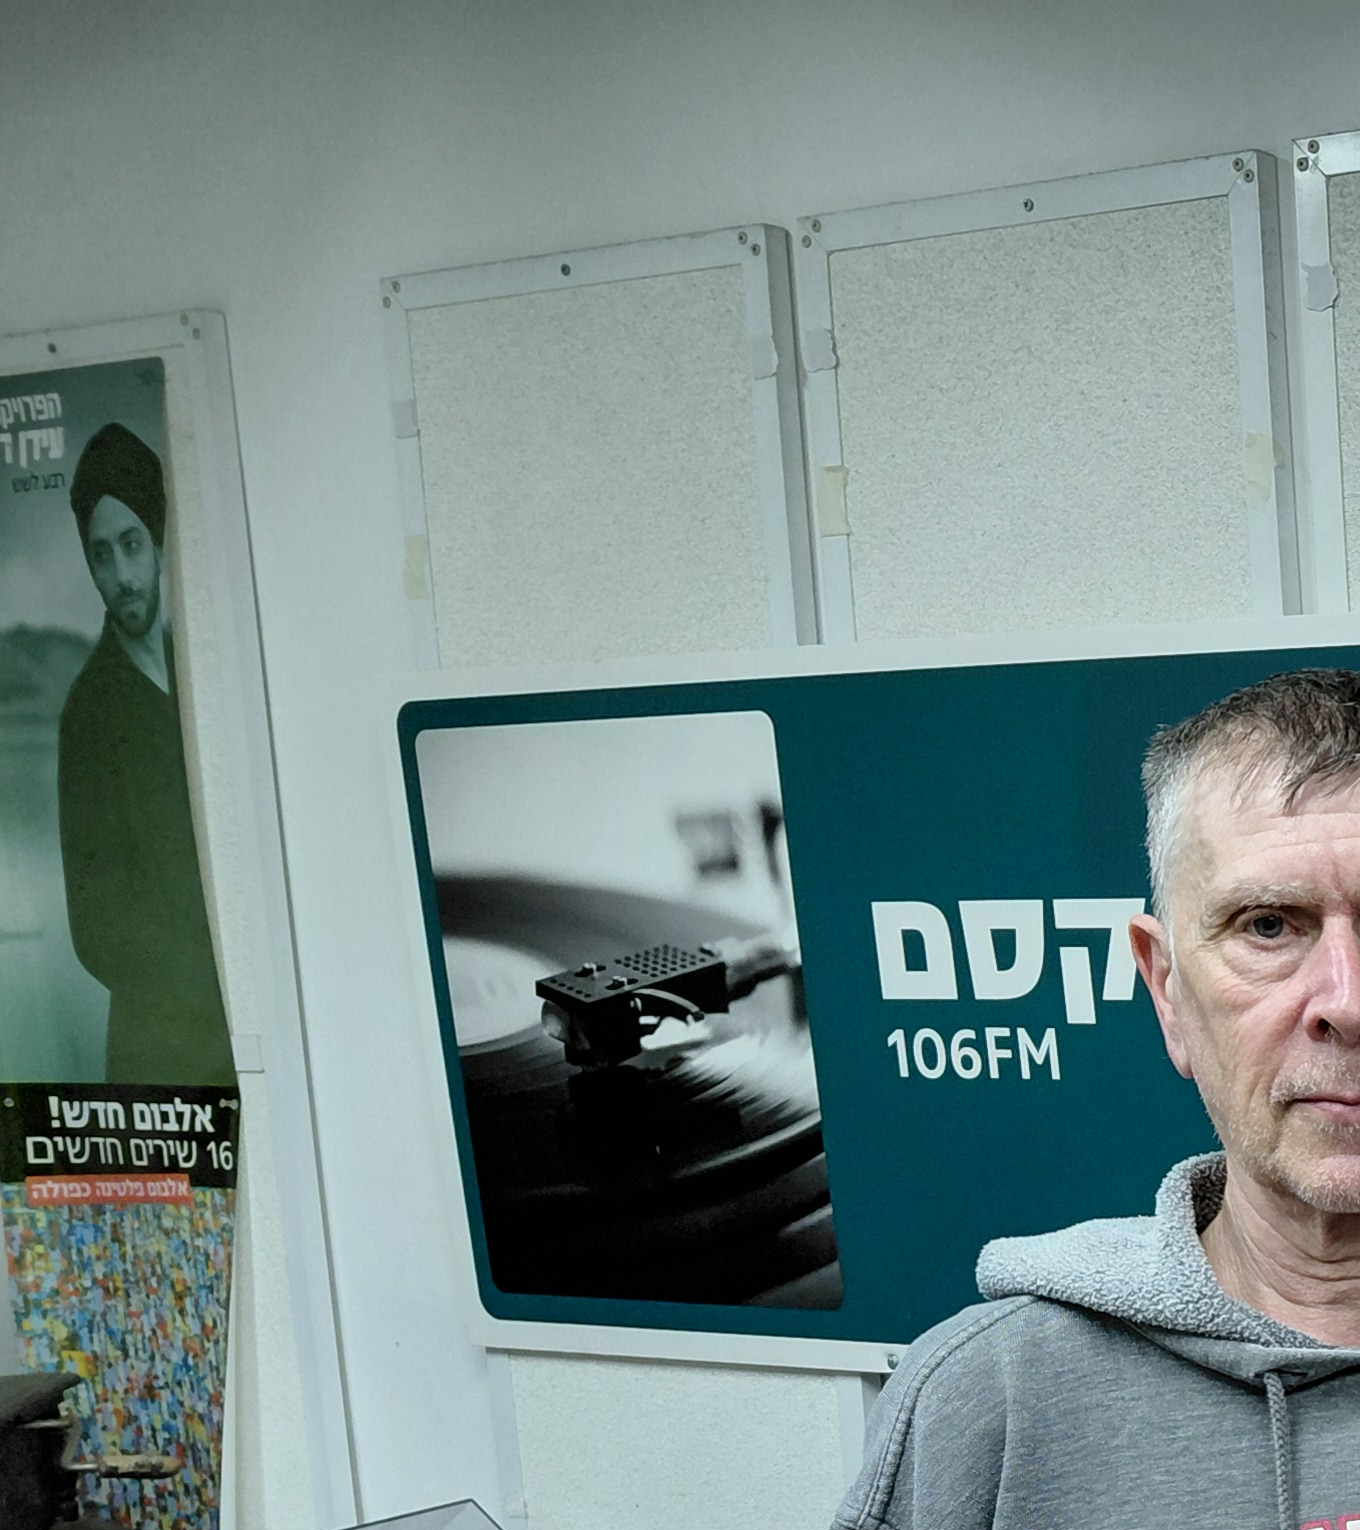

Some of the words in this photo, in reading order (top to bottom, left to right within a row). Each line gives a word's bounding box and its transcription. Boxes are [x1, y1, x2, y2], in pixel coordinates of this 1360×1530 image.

[871, 898, 1146, 1025] קסם
[887, 1027, 1061, 1080] 106FM
[48, 1096, 126, 1130] חדש!
[132, 1097, 215, 1133] אלבום
[26, 1136, 124, 1165] חדשים
[130, 1138, 197, 1169] שירים
[206, 1140, 233, 1170] 16
[32, 1180, 92, 1199] כפולה
[147, 1178, 188, 1197] אלבום
